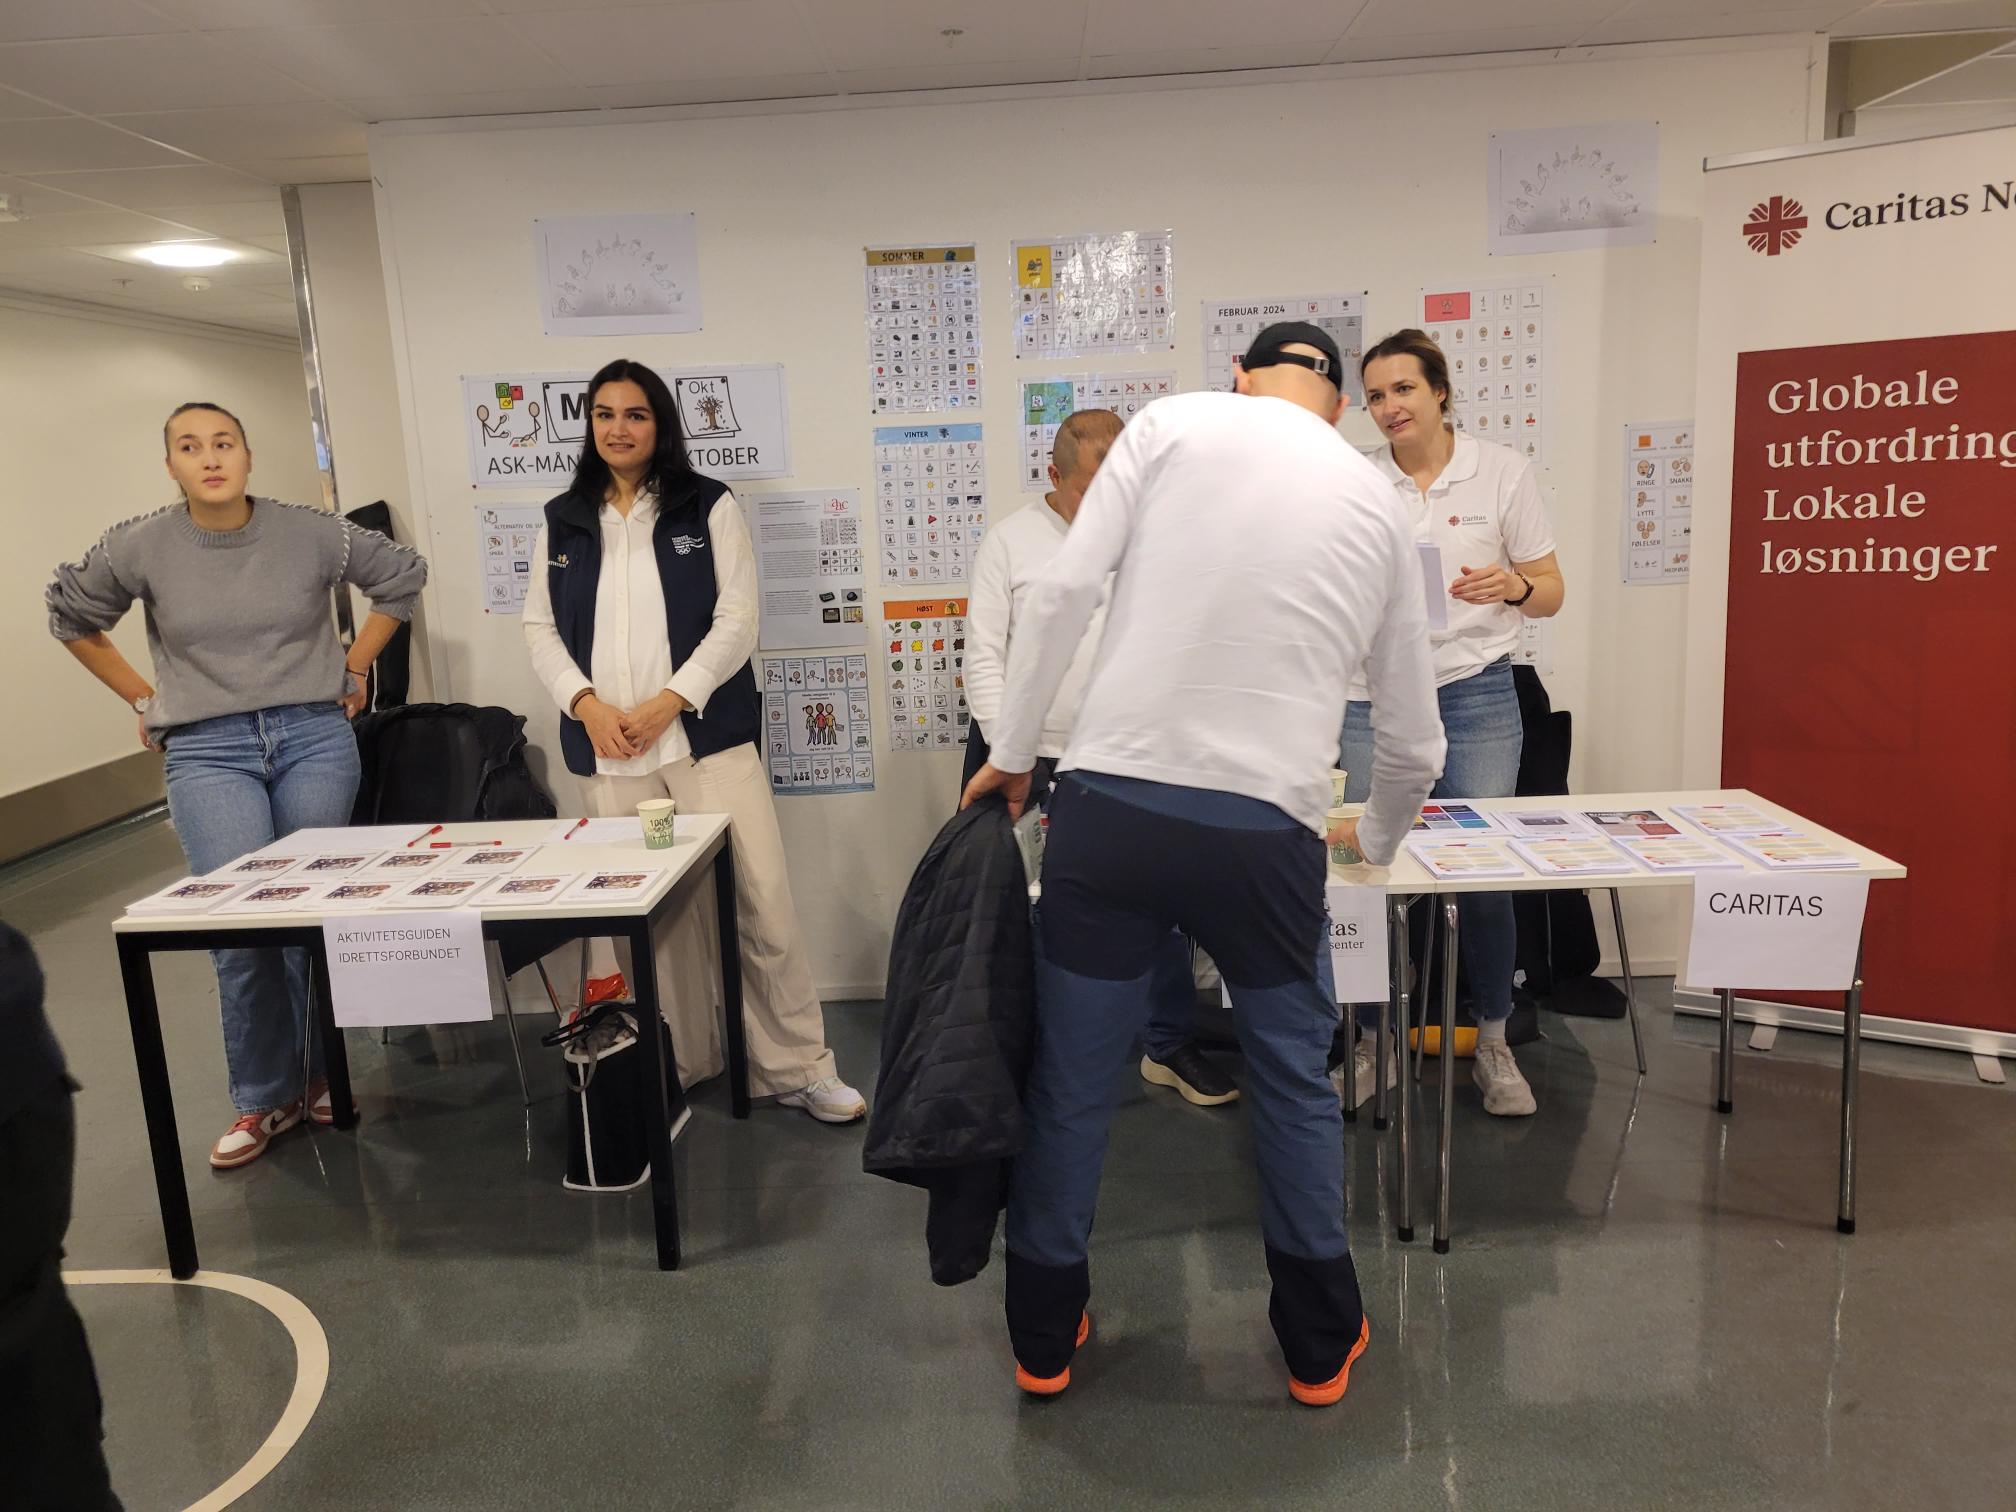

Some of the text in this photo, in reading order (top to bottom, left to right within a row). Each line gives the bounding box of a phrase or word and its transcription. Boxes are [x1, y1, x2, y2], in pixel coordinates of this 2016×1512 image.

[1825, 180, 2016, 230] Caritas N
[882, 251, 925, 262] SOMMER
[1218, 304, 1286, 317] FEBRUAR 2024
[688, 381, 715, 394] Okt
[1767, 369, 1959, 414] Globale
[904, 430, 929, 438] VINTER
[1762, 483, 1926, 520] Lokale
[1631, 540, 1661, 548] FØLELSER
[1760, 537, 1997, 582] løsninger
[1709, 892, 1823, 917] CARITAS
[337, 928, 451, 943] AKTIVITETSGUIDEN
[339, 947, 461, 963] IDRETTSFORBUNDET
